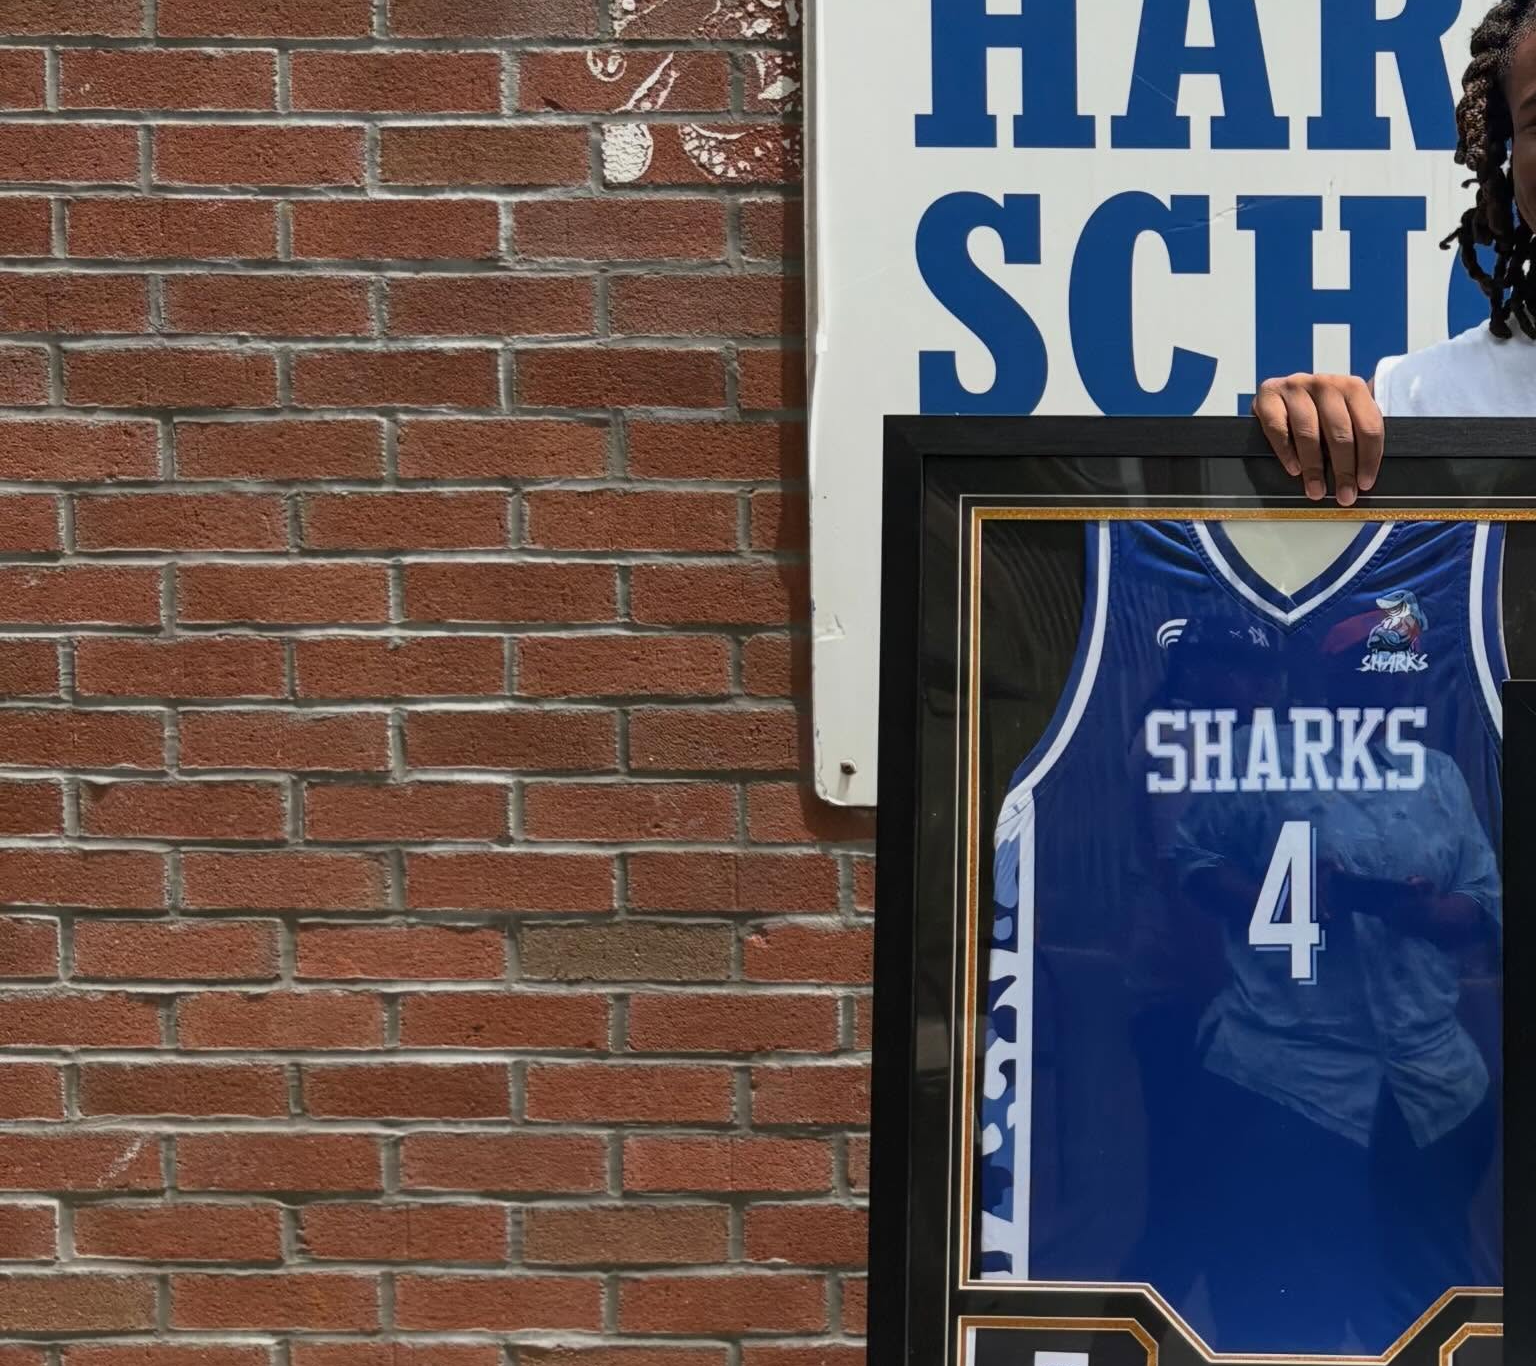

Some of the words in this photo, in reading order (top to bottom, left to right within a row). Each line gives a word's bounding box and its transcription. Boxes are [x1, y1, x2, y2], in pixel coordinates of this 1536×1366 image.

[1356, 651, 1430, 674] SHARKS
[1145, 707, 1428, 794] SHARKS
[1249, 820, 1323, 982] 4
